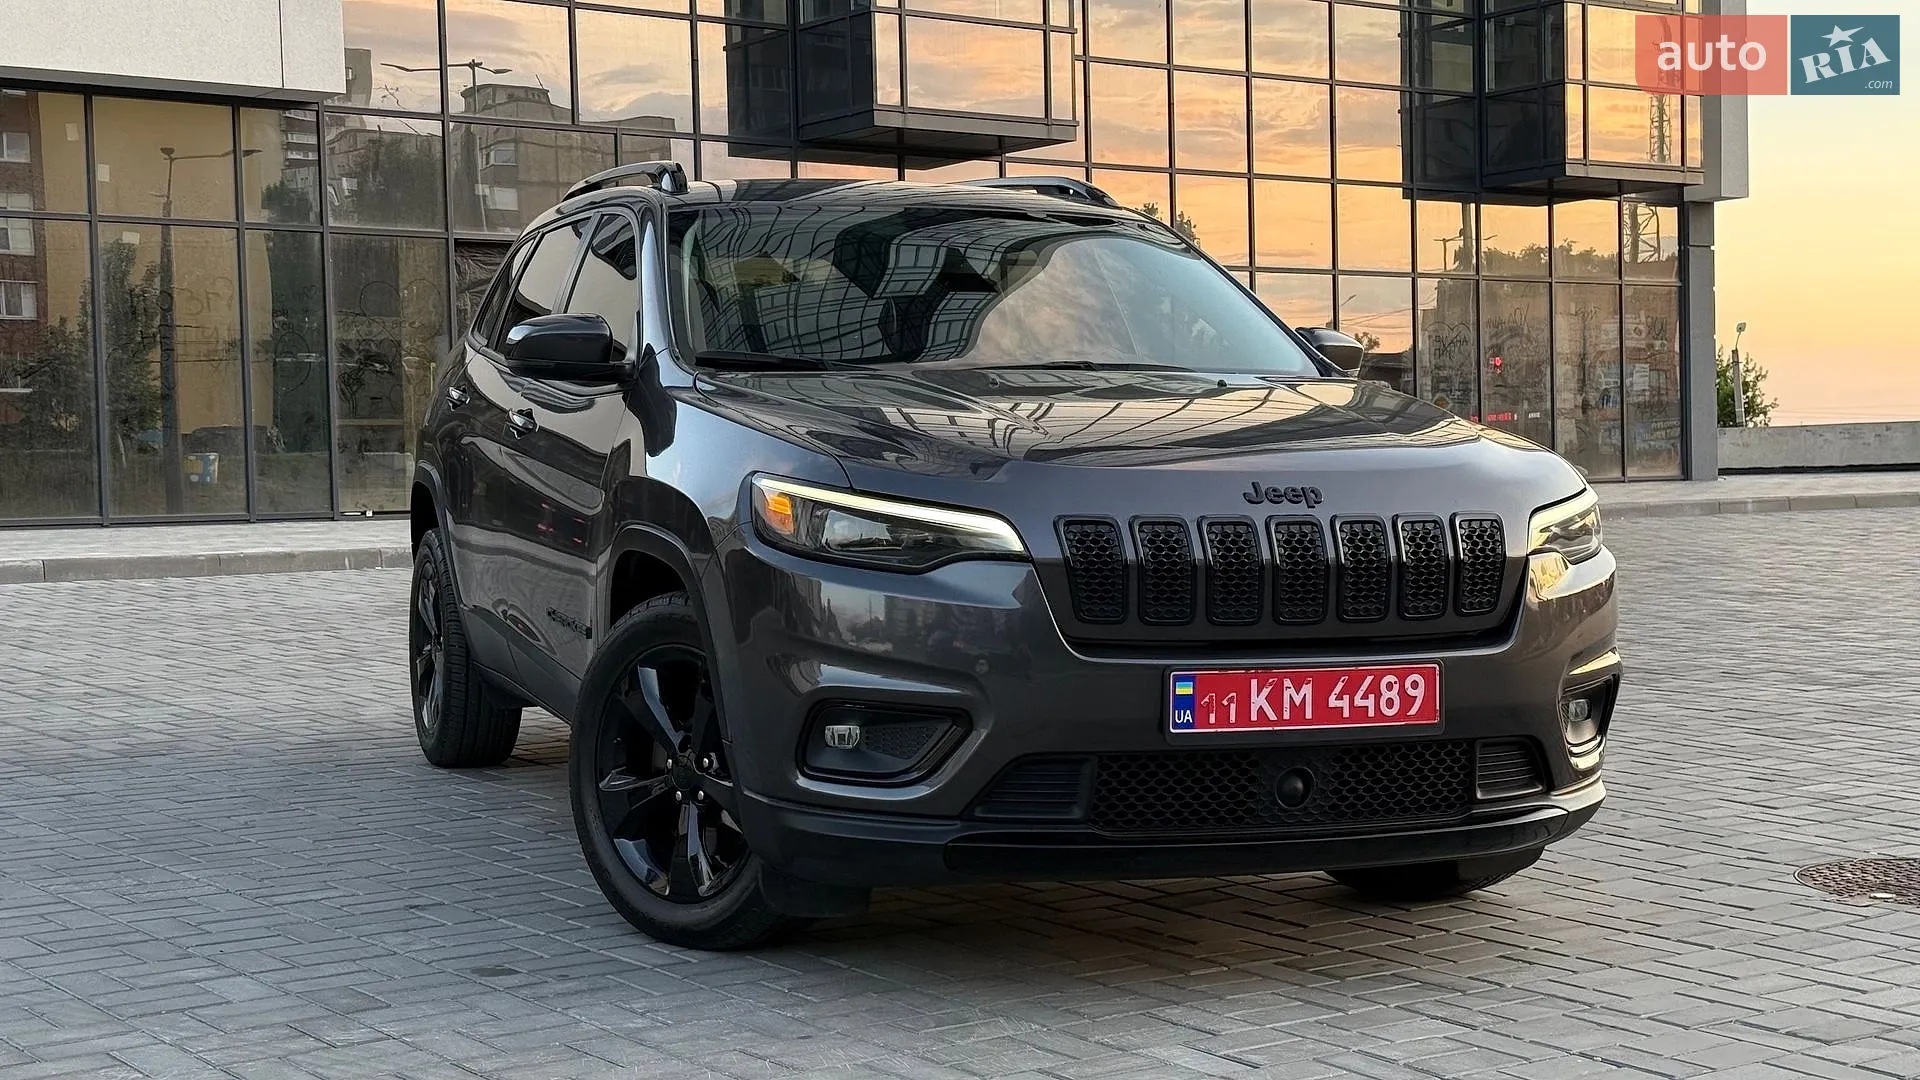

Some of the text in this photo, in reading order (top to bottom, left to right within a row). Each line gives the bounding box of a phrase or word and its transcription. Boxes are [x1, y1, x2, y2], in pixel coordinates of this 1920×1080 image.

[1242, 481, 1323, 509] Jeep
[1200, 673, 1426, 724] 11 KM 4489
[1174, 710, 1193, 724] UA
